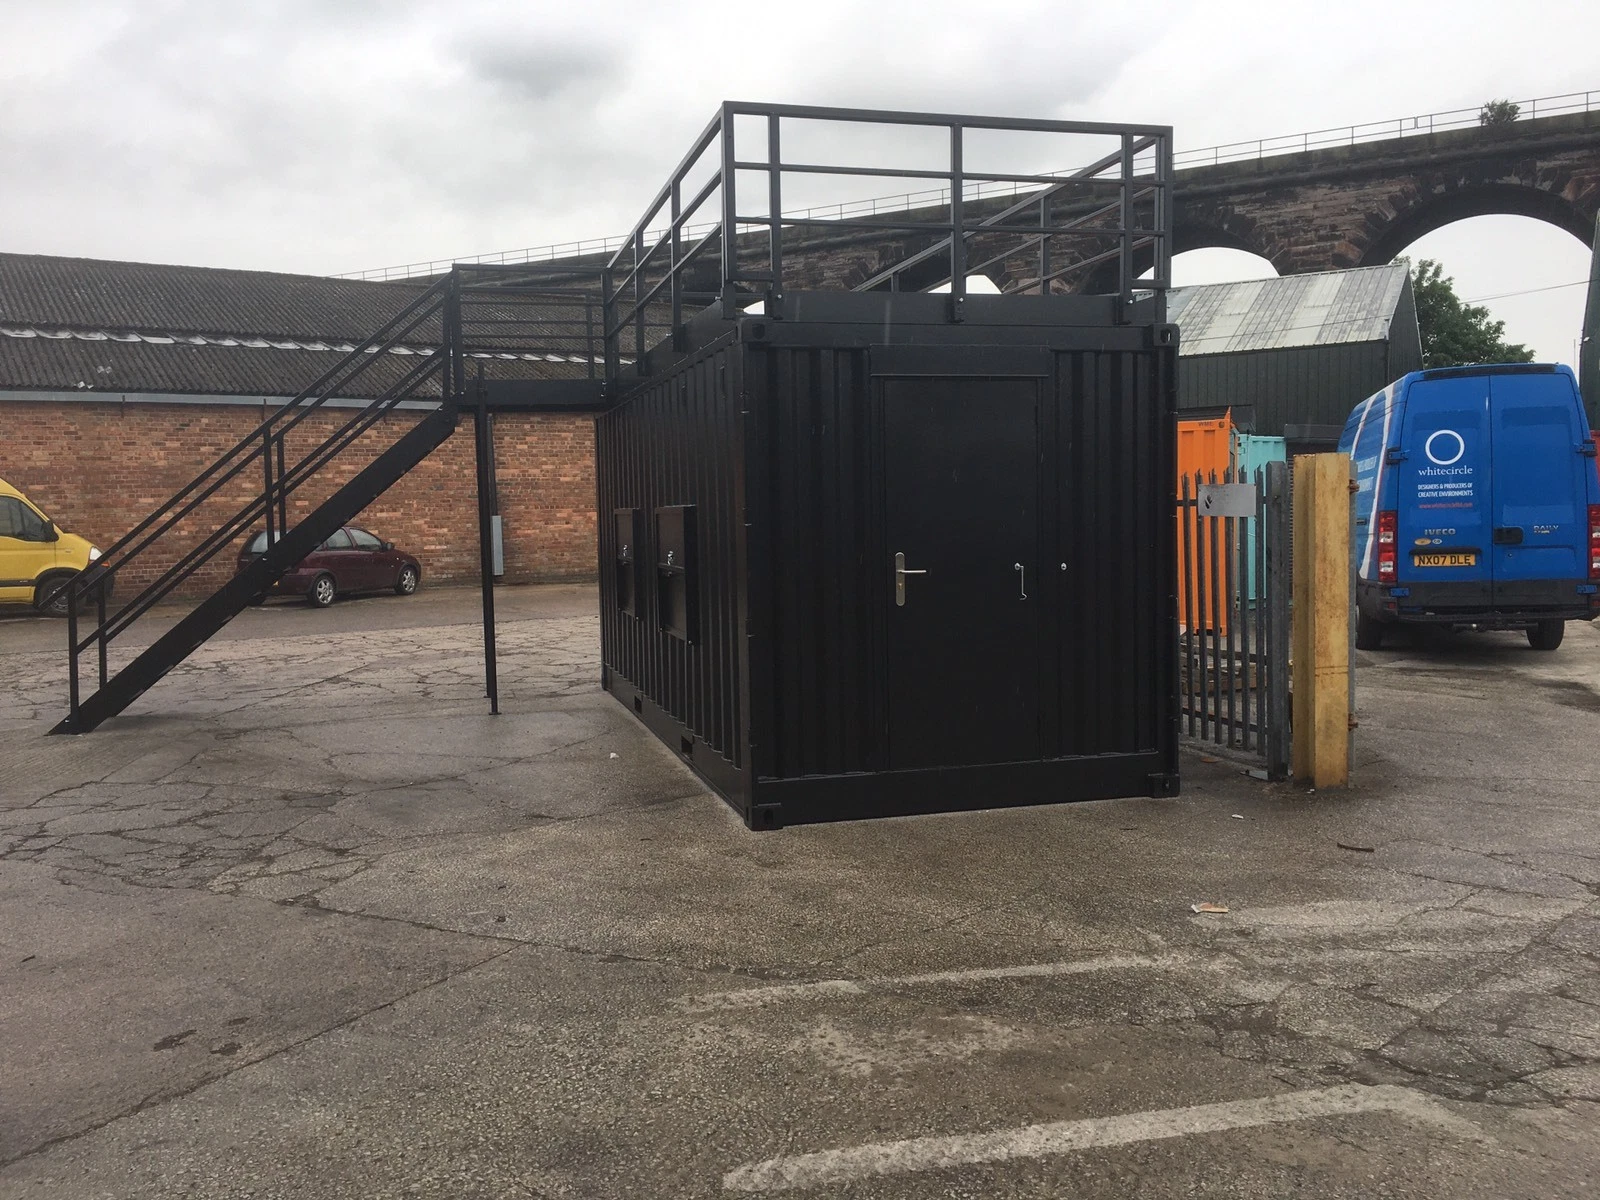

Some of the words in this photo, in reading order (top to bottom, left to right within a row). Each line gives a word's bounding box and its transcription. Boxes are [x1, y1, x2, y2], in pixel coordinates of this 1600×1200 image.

[1418, 465, 1473, 475] whitecircle
[1424, 528, 1456, 536] IVECO
[1418, 555, 1447, 565] NX07
[1450, 554, 1471, 565] DLE
